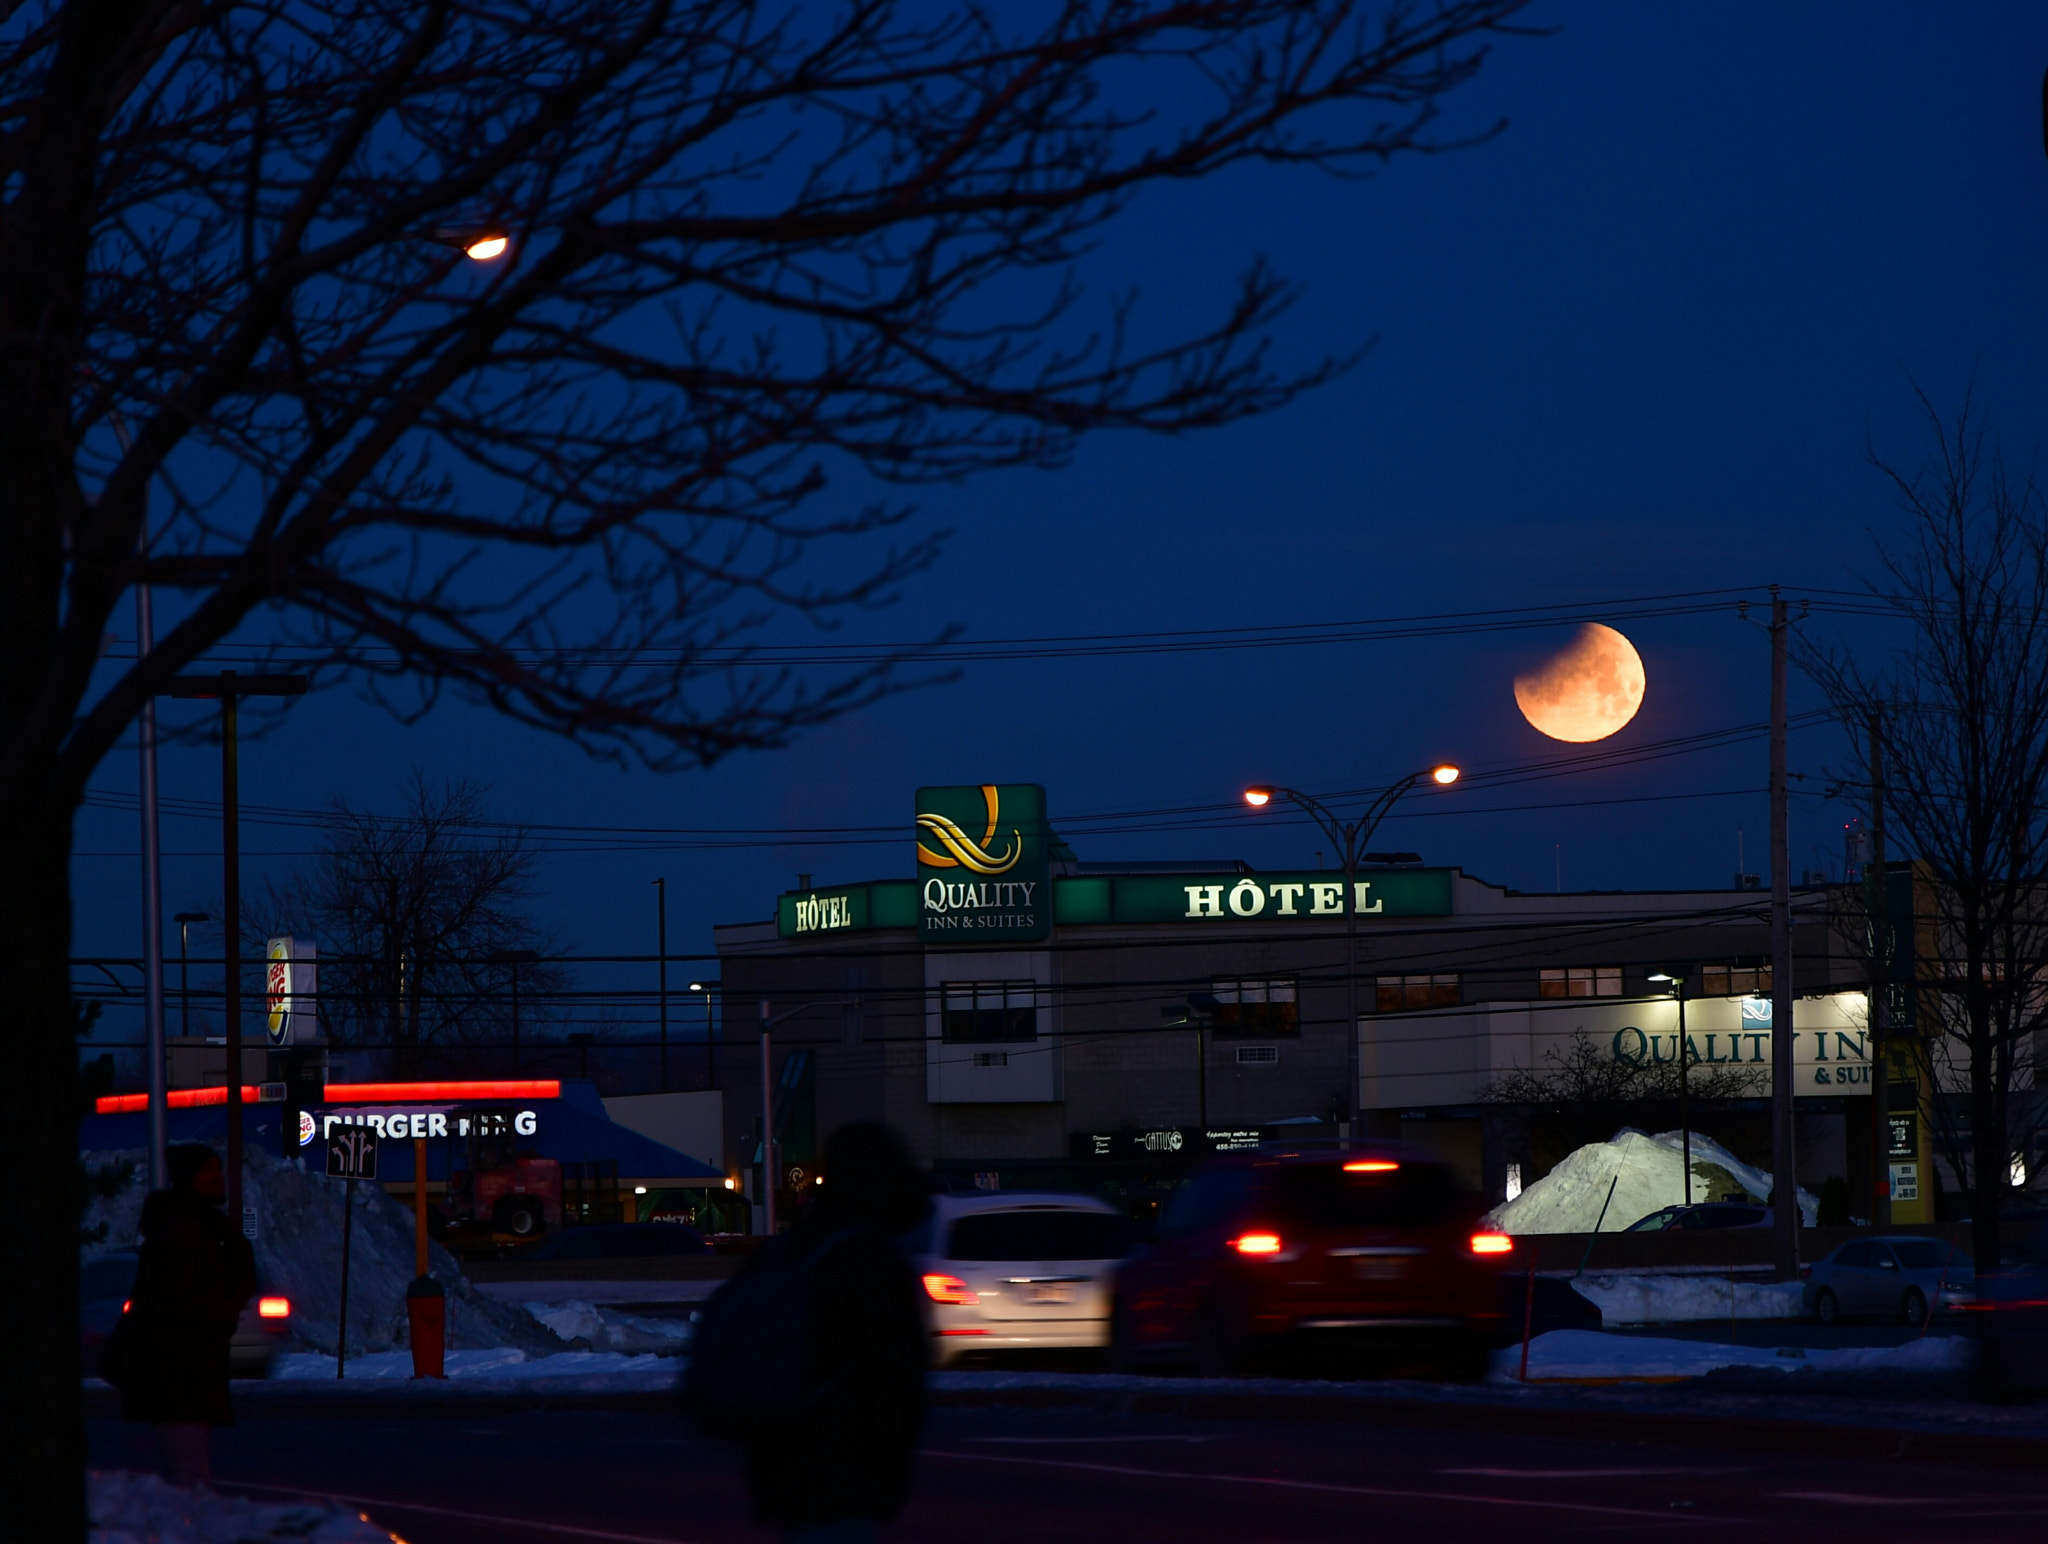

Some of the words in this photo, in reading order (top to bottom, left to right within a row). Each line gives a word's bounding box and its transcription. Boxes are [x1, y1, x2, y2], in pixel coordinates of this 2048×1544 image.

[796, 893, 851, 932] HÔTEL
[924, 878, 1036, 913] QUALITY
[1184, 878, 1383, 917] HÔTEL
[926, 916, 958, 930] INN
[962, 915, 974, 928] &
[978, 914, 1035, 928] SUITES
[1613, 1026, 1800, 1070] QUALIT
[1815, 1031, 1866, 1061] IN
[1815, 1067, 1831, 1084] &
[1836, 1066, 1873, 1084] SUI
